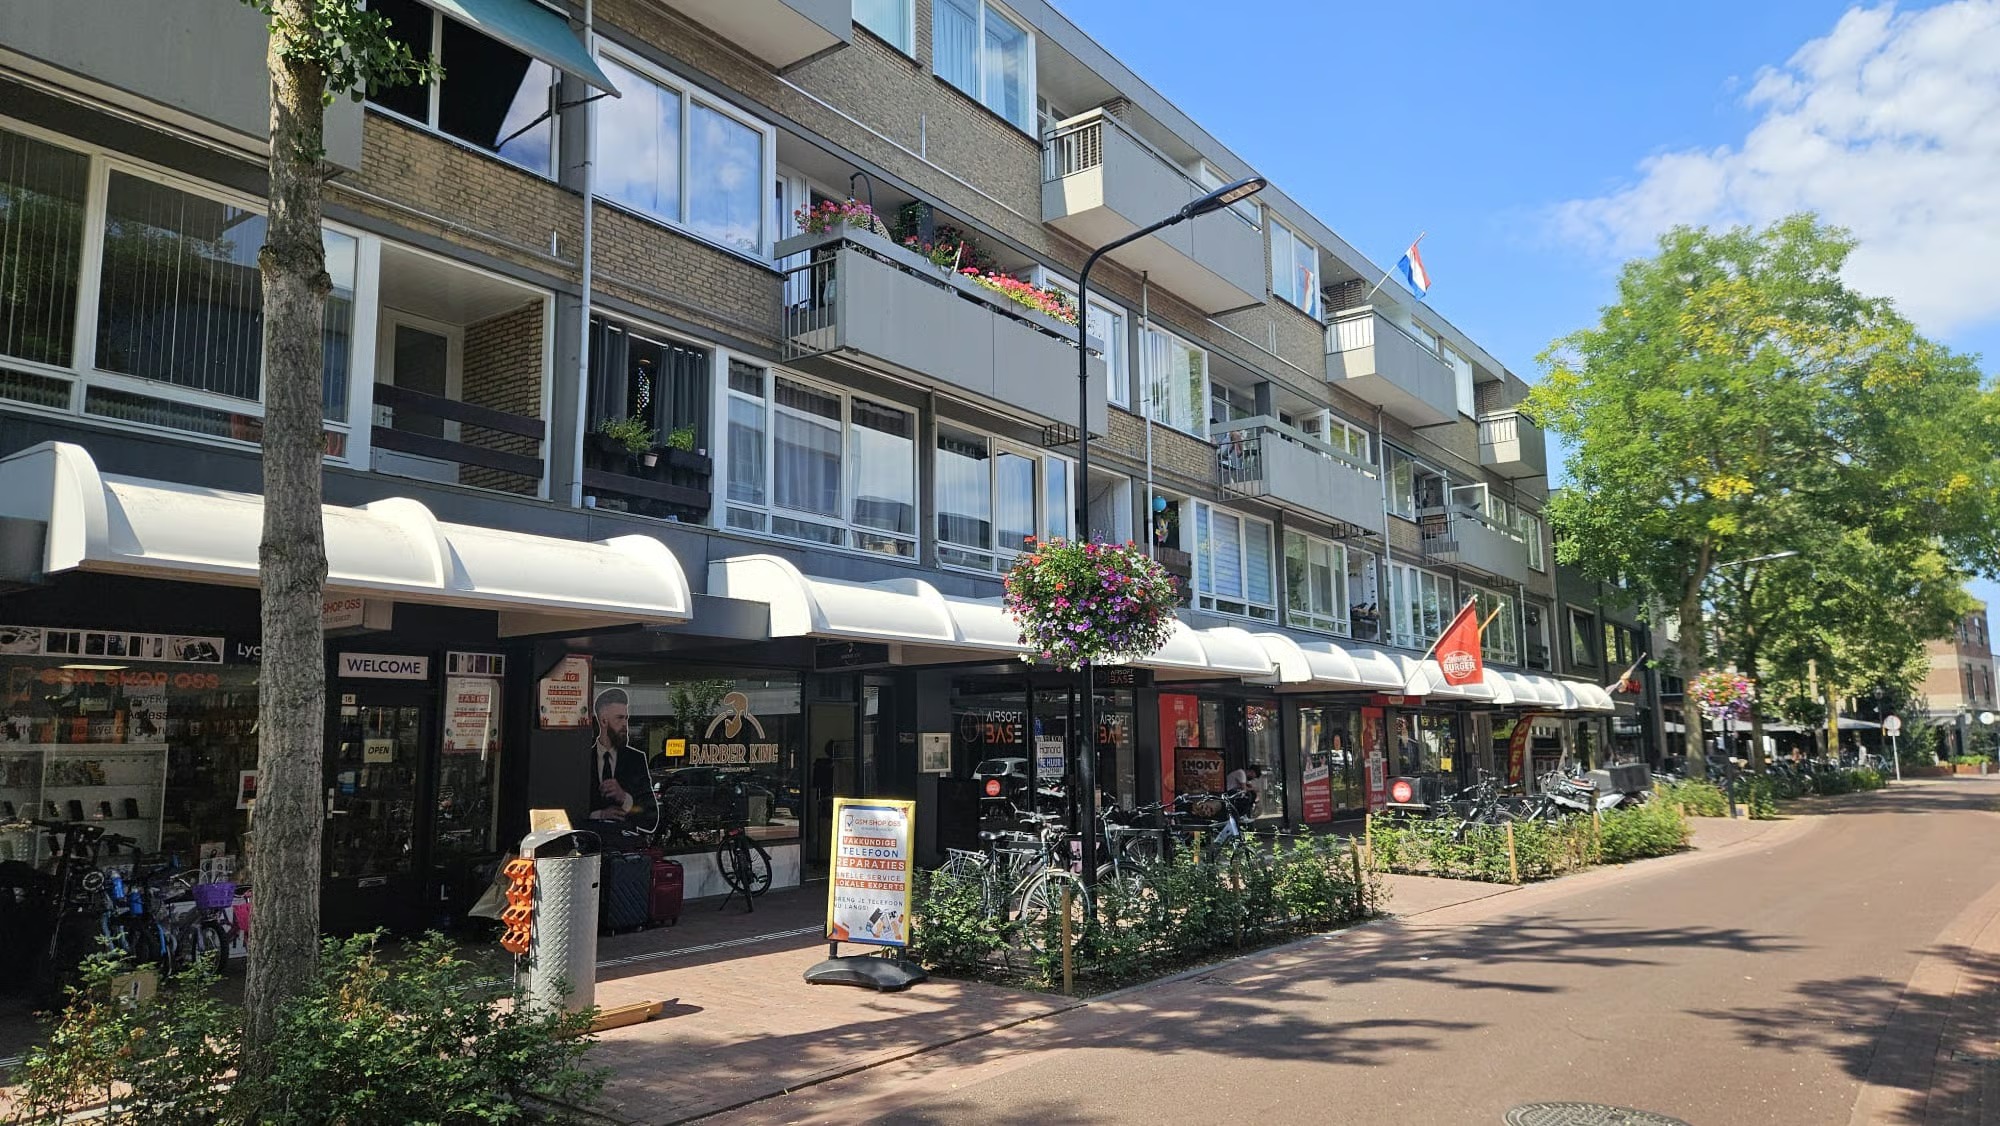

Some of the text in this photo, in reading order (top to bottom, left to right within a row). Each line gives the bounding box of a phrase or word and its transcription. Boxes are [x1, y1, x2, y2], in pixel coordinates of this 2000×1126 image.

[322, 598, 361, 614] SHOP OSS
[347, 658, 421, 674] WELCOME
[1443, 661, 1475, 672] BURGER
[104, 671, 169, 688] SHOP
[173, 673, 219, 689] OSS
[1110, 674, 1134, 683] BASE
[986, 710, 1022, 723] AIRSOFT
[1100, 713, 1129, 726] AIRSOFT
[985, 724, 1022, 744] BASE
[368, 746, 390, 755] OPEN
[689, 743, 747, 765] BARBER
[748, 743, 779, 764] KING
[1509, 721, 1528, 778] OPEN
[1182, 760, 1220, 770] SMOKY
[869, 819, 887, 827] SHOP
[843, 837, 896, 847] VAKKUNDIGE
[843, 847, 899, 858] TELEFOON
[837, 857, 905, 870] REPARATIES
[837, 872, 900, 882] NELLE SERVICE
[836, 880, 904, 891] LOKALE EXPERTS
[868, 898, 903, 907] TELEFOON
